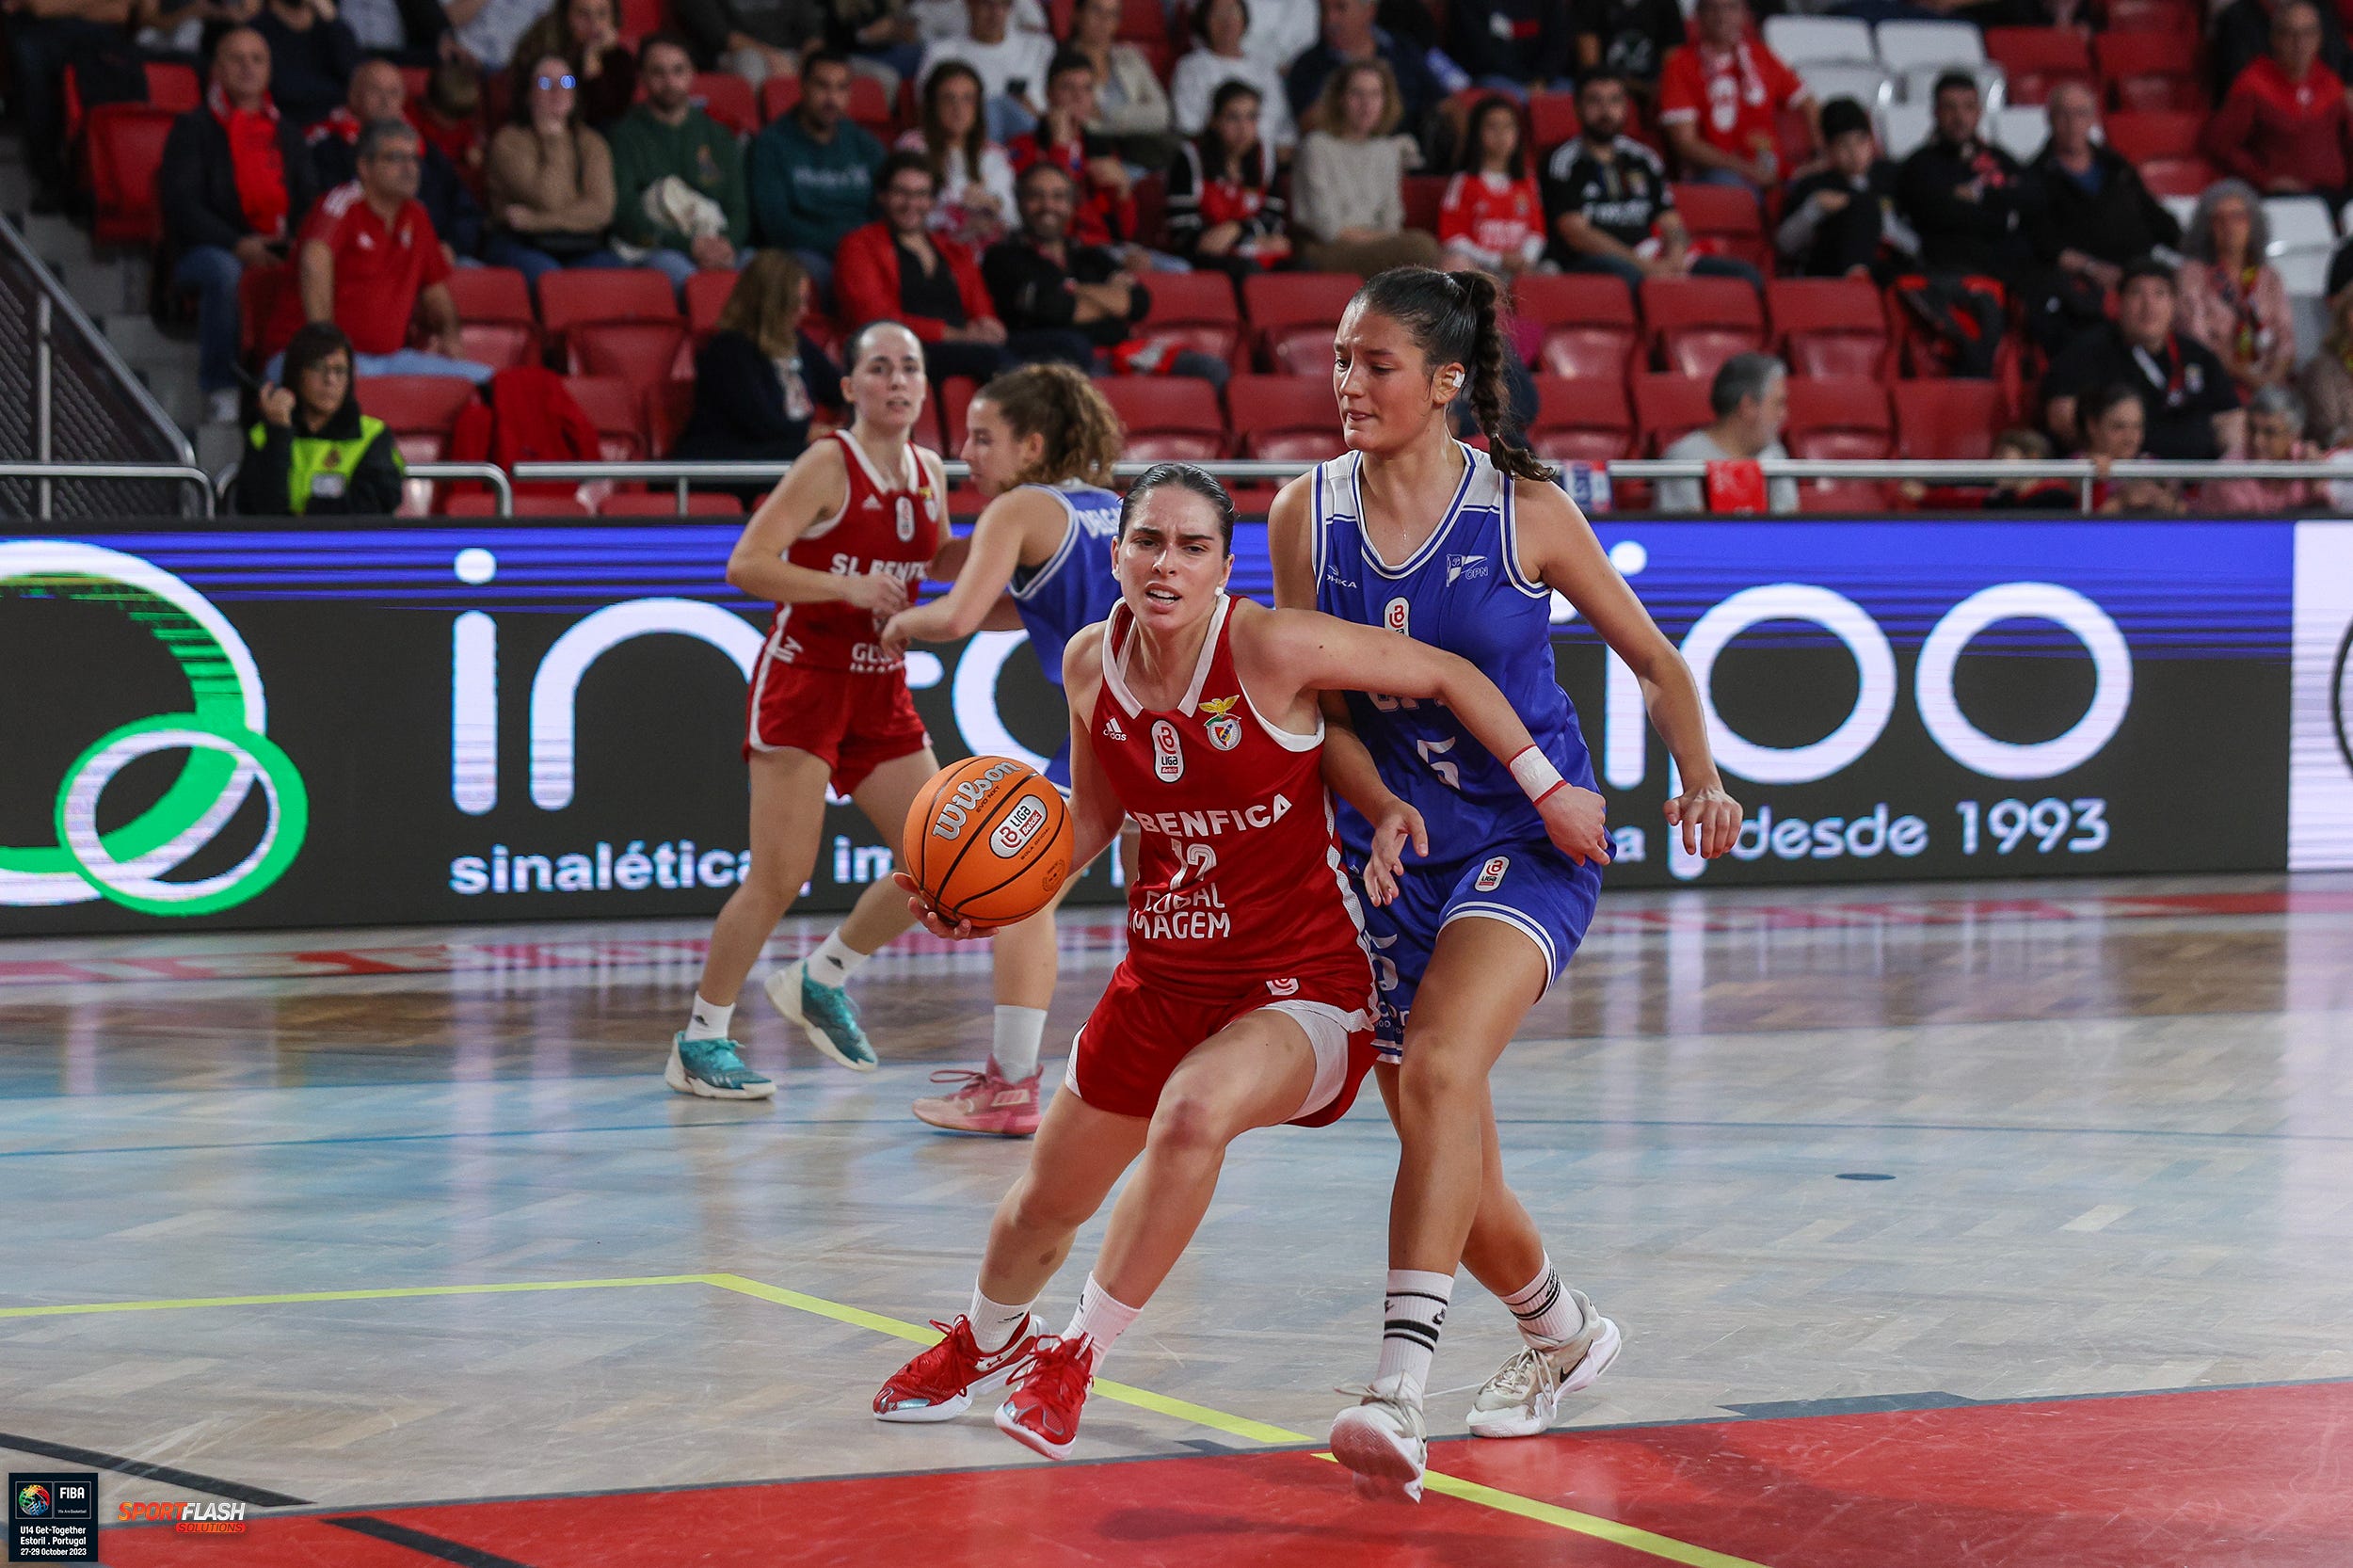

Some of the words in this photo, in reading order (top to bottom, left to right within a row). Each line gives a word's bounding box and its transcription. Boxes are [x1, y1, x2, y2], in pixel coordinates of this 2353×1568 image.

[932, 761, 1024, 840] Wilson
[1133, 792, 1293, 837] BENFICA
[1730, 803, 1930, 860] desde
[1956, 797, 2111, 856] 1993
